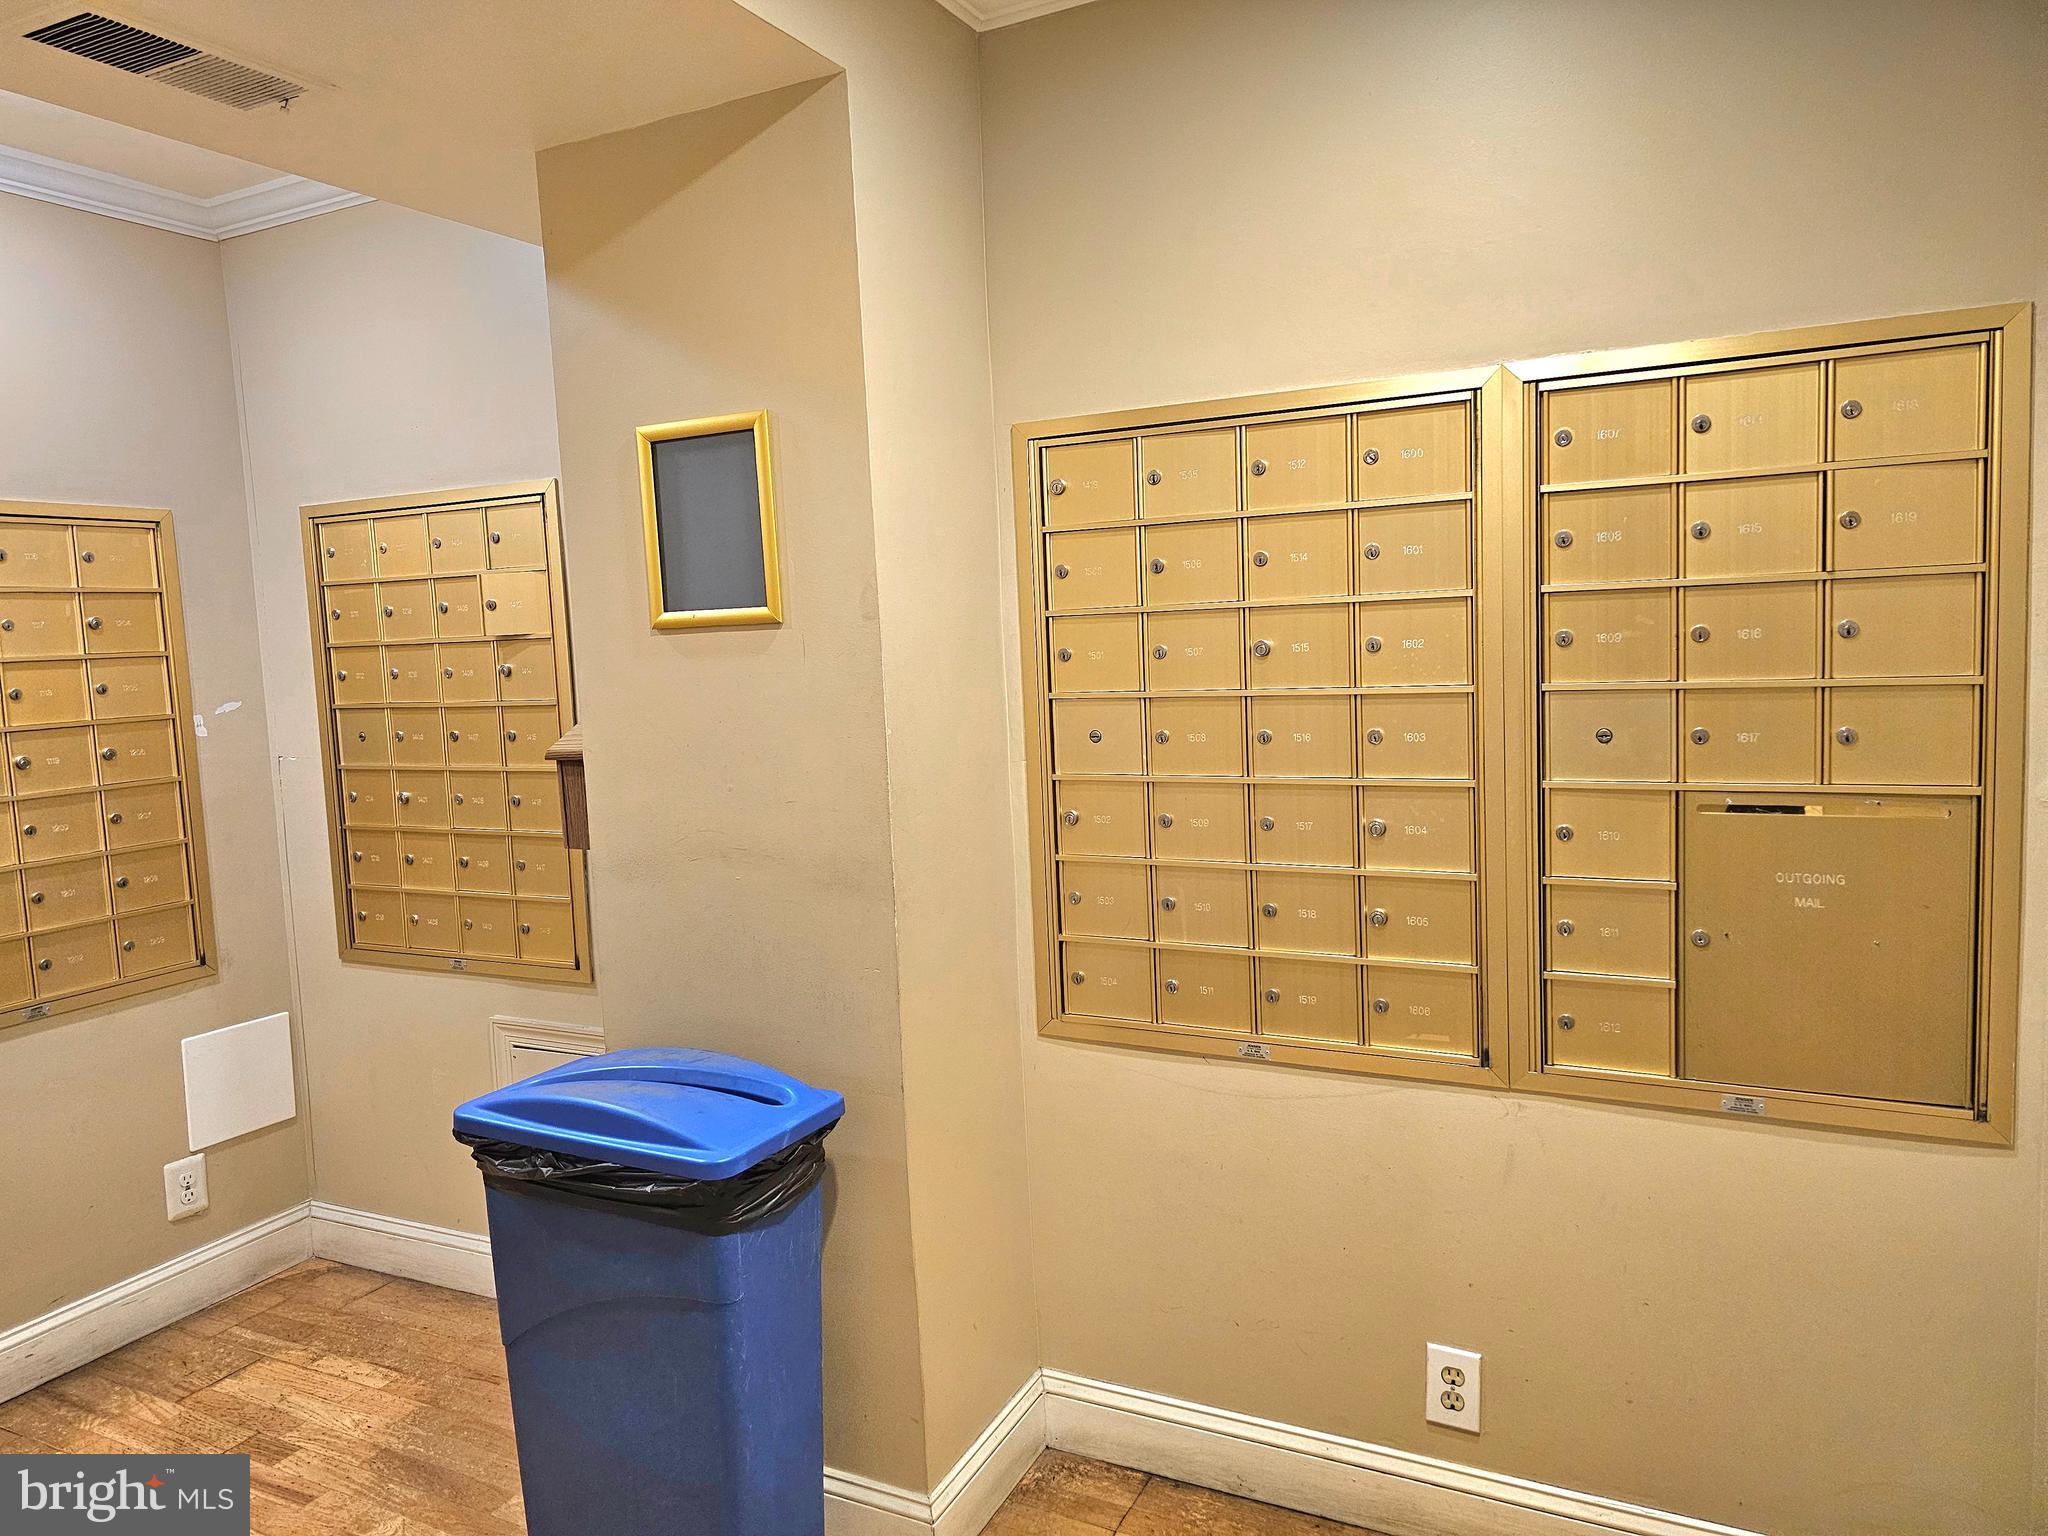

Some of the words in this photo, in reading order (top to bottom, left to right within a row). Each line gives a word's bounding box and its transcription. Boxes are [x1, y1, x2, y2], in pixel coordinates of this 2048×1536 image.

[1596, 428, 1621, 440] 1607
[1400, 447, 1424, 459] 1600
[1288, 458, 1306, 470] 1512
[1890, 511, 1917, 523] 1619
[1737, 522, 1762, 534] 1615
[1596, 530, 1622, 542] 1608
[1402, 544, 1424, 555] 1601
[1289, 551, 1308, 563] 1514
[1182, 558, 1201, 569] 1506
[1596, 632, 1622, 644] 1609
[1737, 628, 1762, 639] 1616
[1291, 642, 1310, 653] 1515
[1402, 638, 1425, 650] 1602
[1088, 650, 1104, 660] 1501
[1185, 646, 1204, 657] 1507
[1186, 732, 1206, 742] 1508
[1293, 732, 1311, 743] 1516
[1403, 732, 1426, 743] 1603
[1736, 732, 1760, 743] 1617
[1093, 814, 1111, 824] 1502
[1189, 817, 1209, 828] 1509
[1295, 820, 1313, 831] 1517
[1404, 824, 1427, 836] 1604
[1597, 830, 1620, 841] 1610
[1776, 872, 1846, 885] OUTGOING
[1097, 895, 1114, 905] 1503
[1794, 896, 1825, 909] MAIL
[1194, 902, 1211, 912] 1510
[1298, 909, 1317, 919] 1518
[1406, 916, 1429, 927] 1605
[1599, 927, 1619, 938] 1611
[1100, 976, 1118, 986] 1504
[1199, 985, 1214, 995] 1511
[1298, 994, 1317, 1005] 1519
[1409, 1006, 1431, 1016] 1606
[1599, 1022, 1621, 1033] 1612
